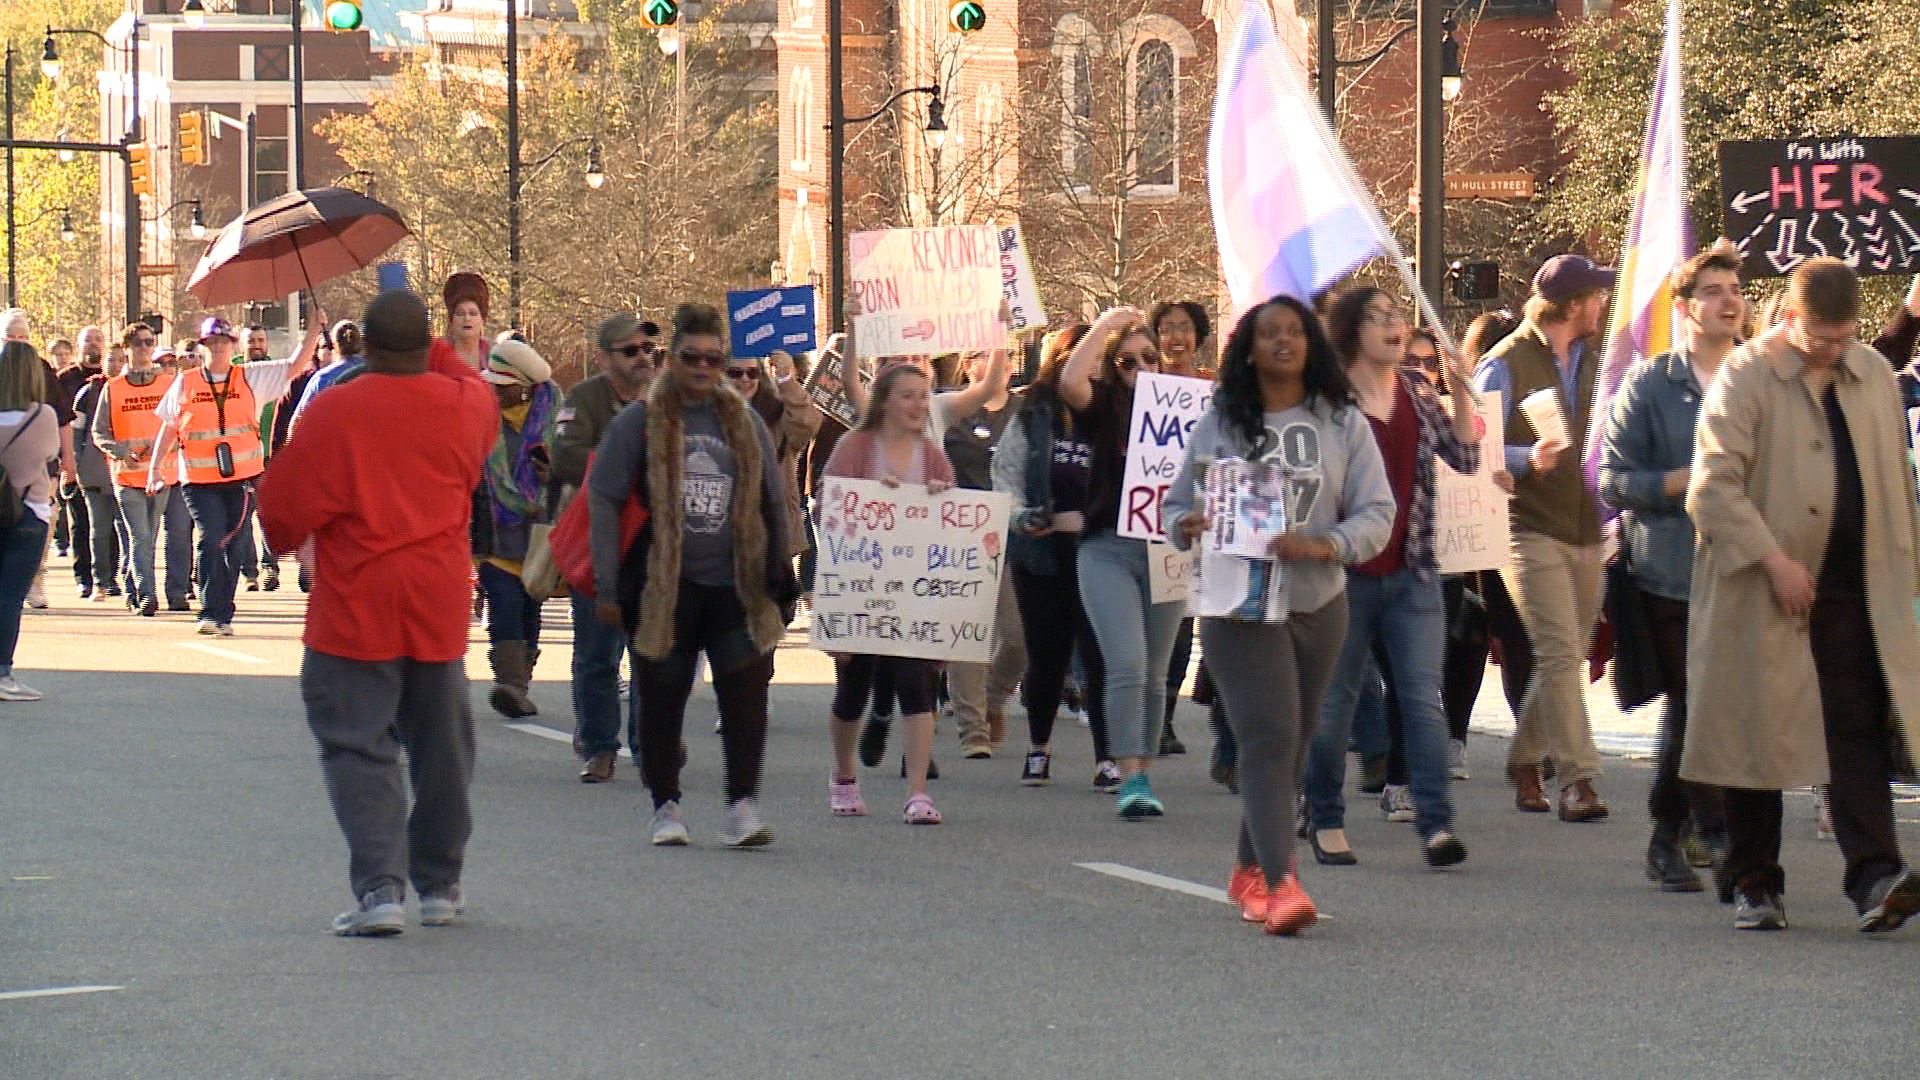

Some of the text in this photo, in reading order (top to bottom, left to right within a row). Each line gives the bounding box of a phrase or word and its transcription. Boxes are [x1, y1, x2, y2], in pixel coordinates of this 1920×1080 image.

[1450, 180, 1526, 190] N HULL STREET
[1771, 163, 1889, 210] HER
[911, 227, 995, 273] REVENGE
[853, 275, 900, 314] PORN
[860, 314, 898, 355] ARE
[937, 308, 1007, 351] WOMEN
[140, 394, 163, 403] CHOIC
[1152, 380, 1210, 411] We'r
[680, 480, 722, 497] USTICE
[844, 491, 897, 530] Roses
[941, 501, 991, 531] RED
[828, 535, 883, 570] Violets
[927, 544, 980, 571] BLUE
[851, 576, 875, 592] not
[885, 579, 904, 594] an
[912, 577, 983, 598] OBJECT
[817, 612, 988, 649] NEITHER ARE YOU
